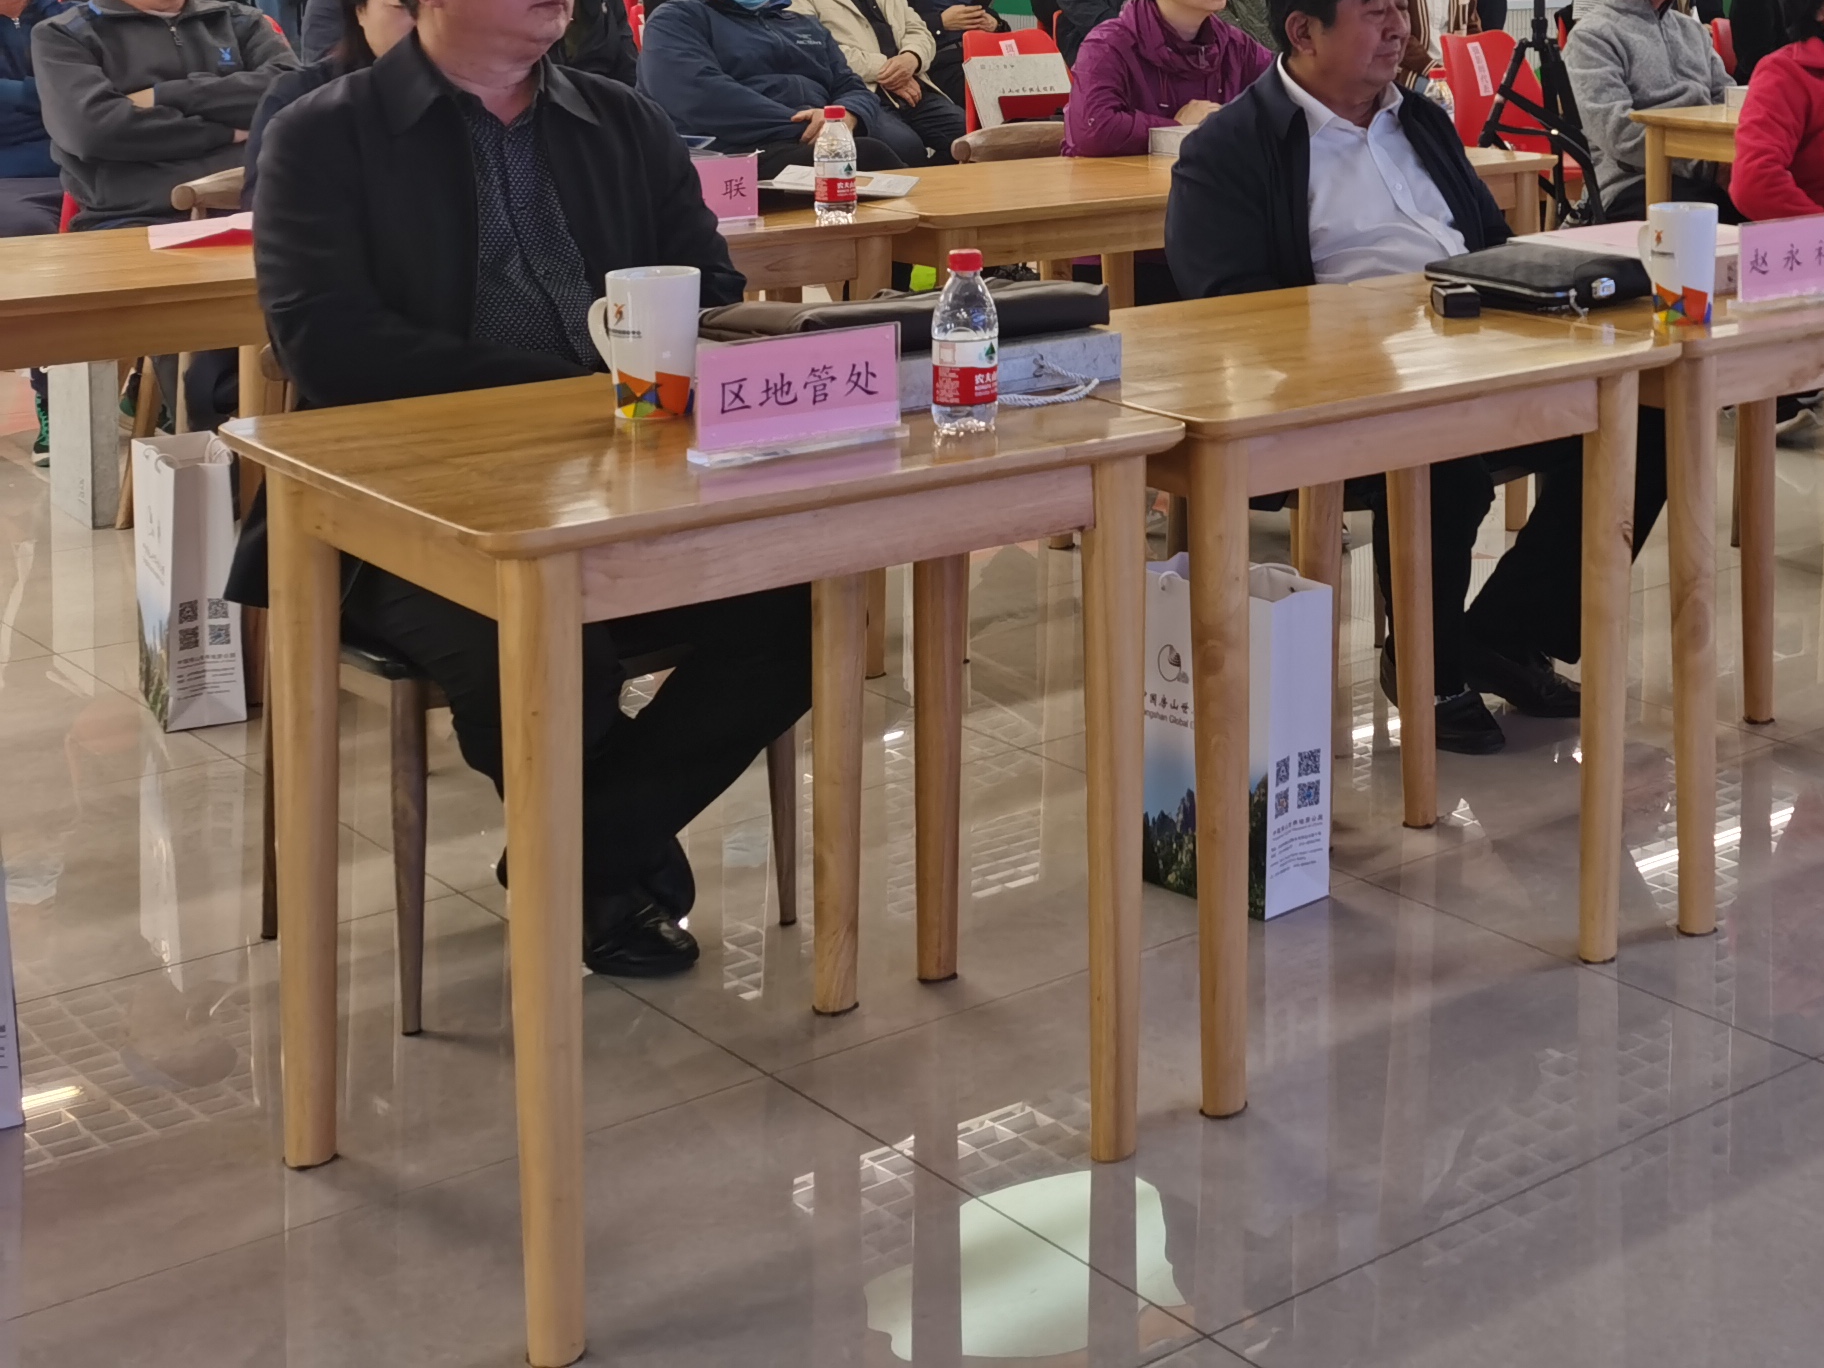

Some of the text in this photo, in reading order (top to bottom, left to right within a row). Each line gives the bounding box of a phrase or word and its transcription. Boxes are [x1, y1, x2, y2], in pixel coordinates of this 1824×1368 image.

[721, 176, 747, 200] 联
[721, 361, 879, 414] 区地管处
[1144, 691, 1193, 714] 国房山世
[1169, 714, 1189, 728] Global
